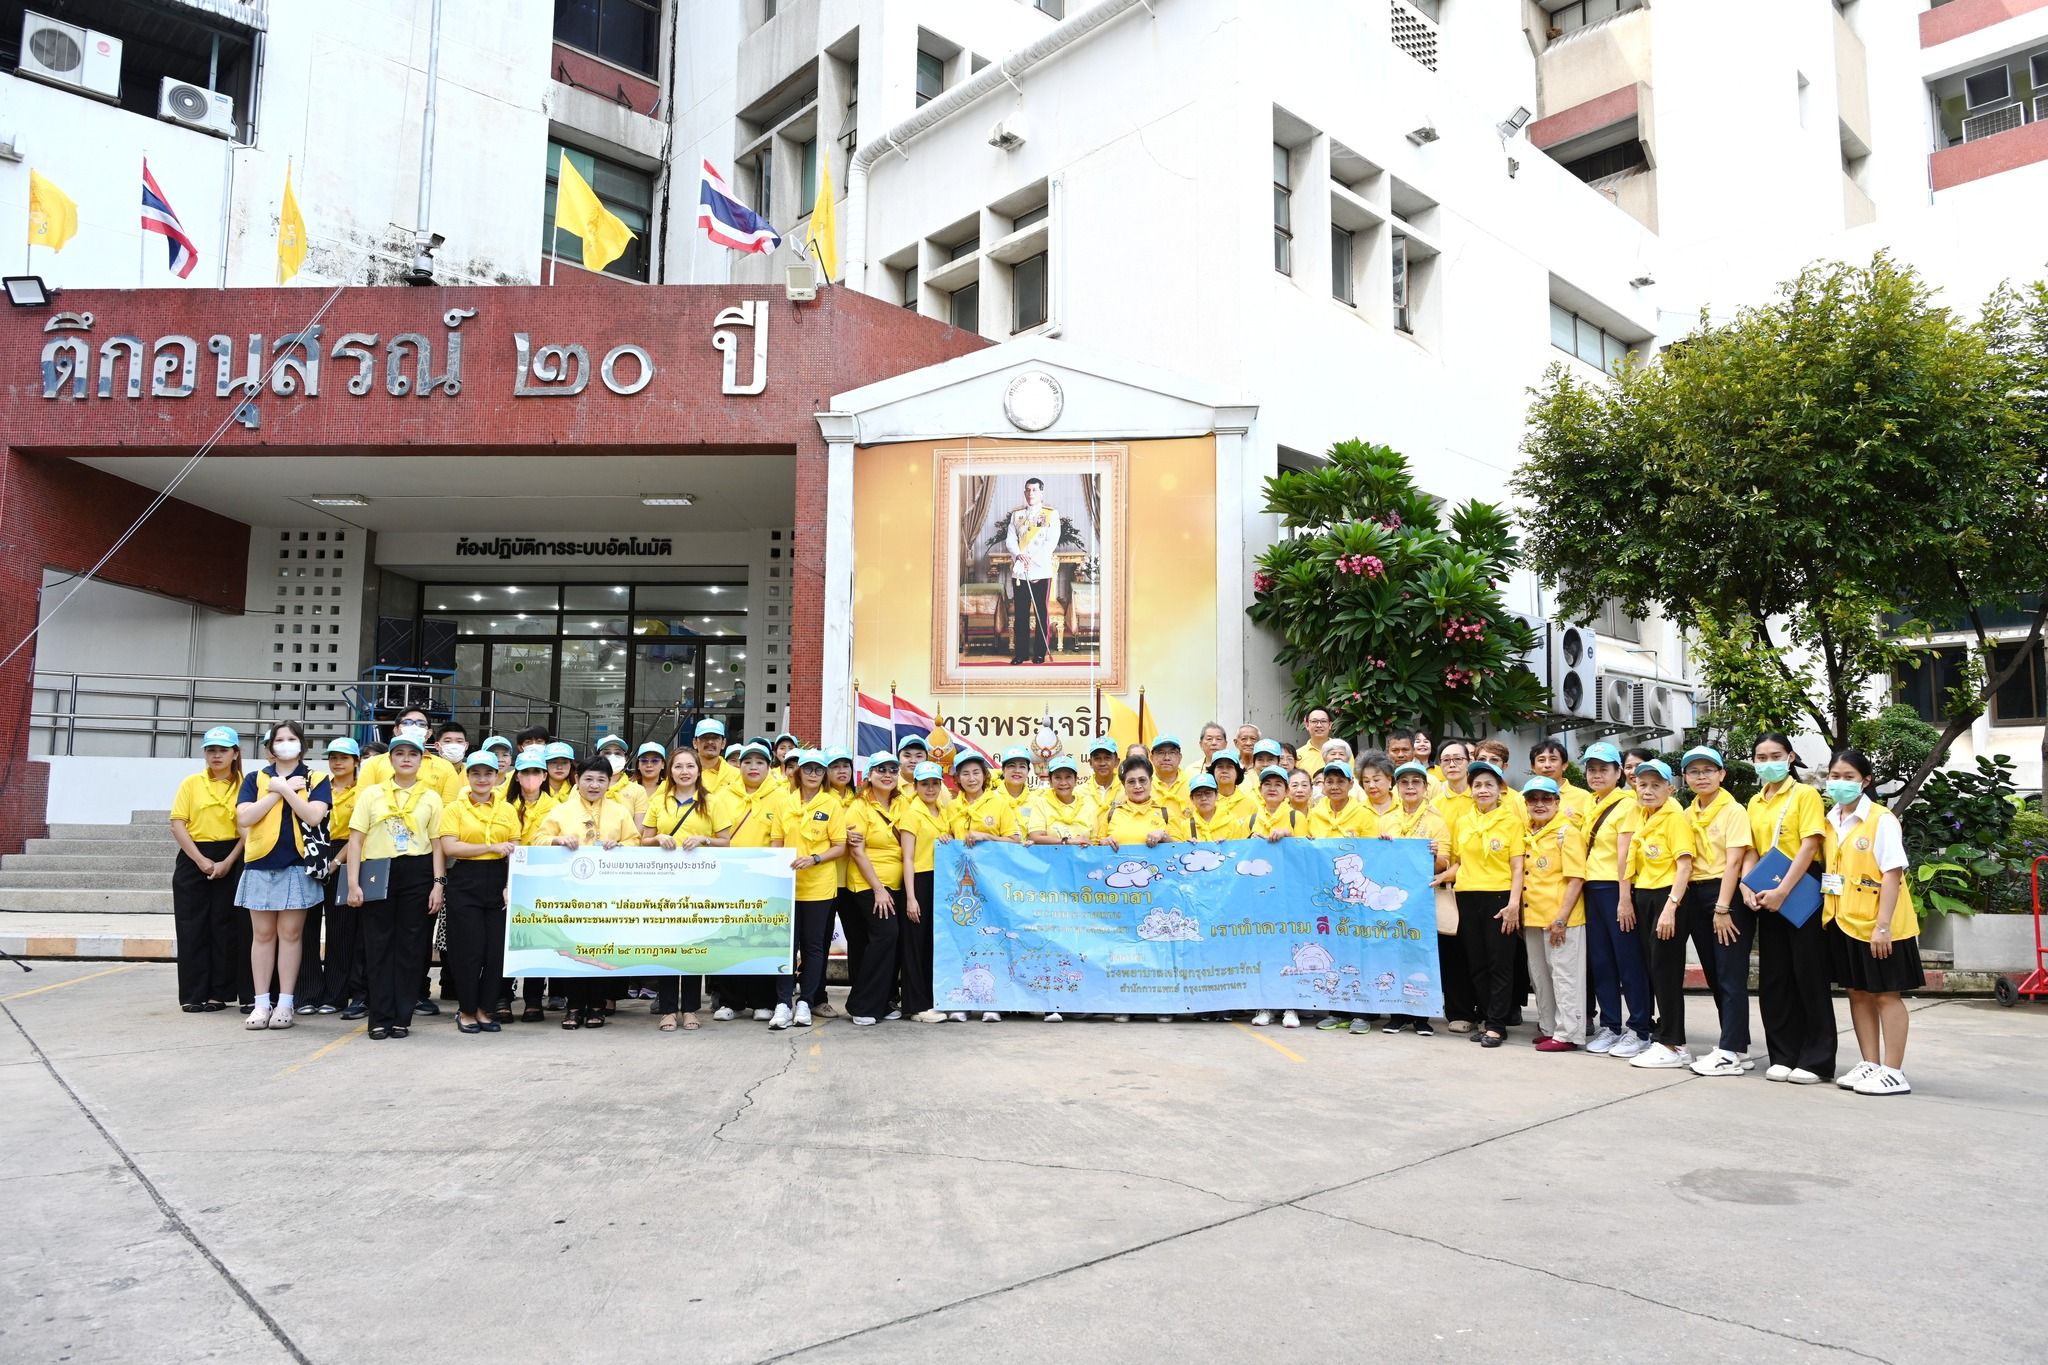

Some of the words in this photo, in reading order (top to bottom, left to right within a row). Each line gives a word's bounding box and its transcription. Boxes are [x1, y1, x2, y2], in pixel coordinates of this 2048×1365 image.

[40, 306, 479, 430] ตึกอนุสรณ์
[512, 331, 656, 398] ๒๐
[711, 299, 770, 396] ปี
[455, 536, 673, 560] ห้องปฏิบัติการระบบอัตโนมัติ
[535, 898, 608, 910] กิจกรรมจิตอาสา
[1001, 882, 1153, 905] โครงการจิตอาสา
[1210, 917, 1312, 938] เราทำความ
[1316, 915, 1331, 936] ดี
[1335, 916, 1421, 941] ด้วยหัวใจ
[634, 947, 677, 957] กรกฎาคม
